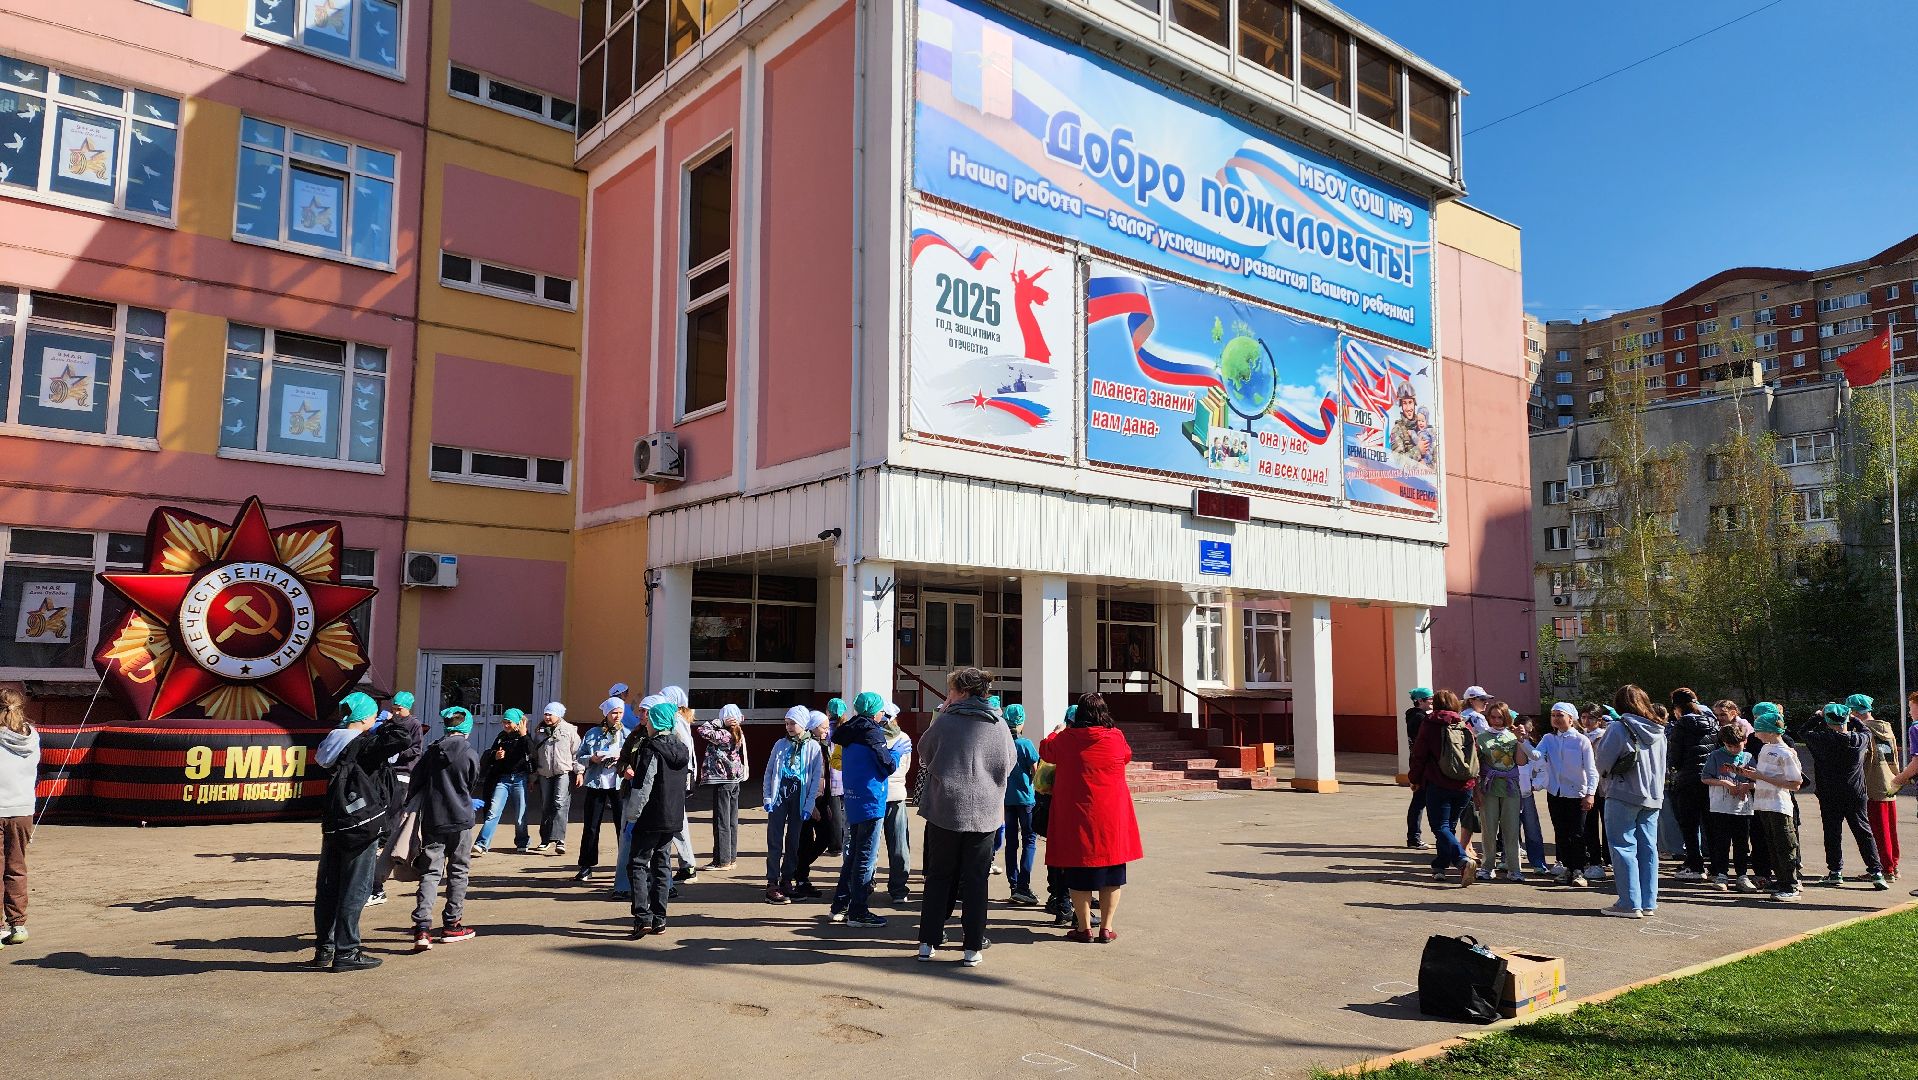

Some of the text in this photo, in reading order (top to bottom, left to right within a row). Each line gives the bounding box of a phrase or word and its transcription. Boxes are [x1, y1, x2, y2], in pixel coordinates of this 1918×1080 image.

[1045, 109, 1187, 204] Добро
[1300, 163, 1413, 228] МБОУ СОШ №9
[950, 149, 1008, 192] Наша
[1013, 178, 1082, 217] работа
[1108, 210, 1155, 242] залог
[1158, 228, 1241, 269] успешного
[1244, 257, 1308, 291] развития
[1311, 274, 1360, 307] Вашего
[1362, 294, 1415, 324] ребенка!
[1201, 175, 1412, 286] пожаловать!
[935, 272, 1001, 327] 2025
[1092, 379, 1195, 413] планета знаний
[1092, 411, 1121, 431] нам
[1354, 409, 1372, 427] 2025
[1259, 431, 1308, 454] она у нас
[1258, 459, 1272, 475] на
[1274, 462, 1299, 480] всех
[1301, 467, 1329, 484] одна!
[1399, 485, 1416, 499] НАШЕ
[187, 567, 310, 667] ОТЕЧЕСТВЕННАЯ ВОЙНА
[184, 745, 307, 780] 9 МАЯ
[183, 782, 303, 804] С ДНЕМ ПОБЕДЫ!
